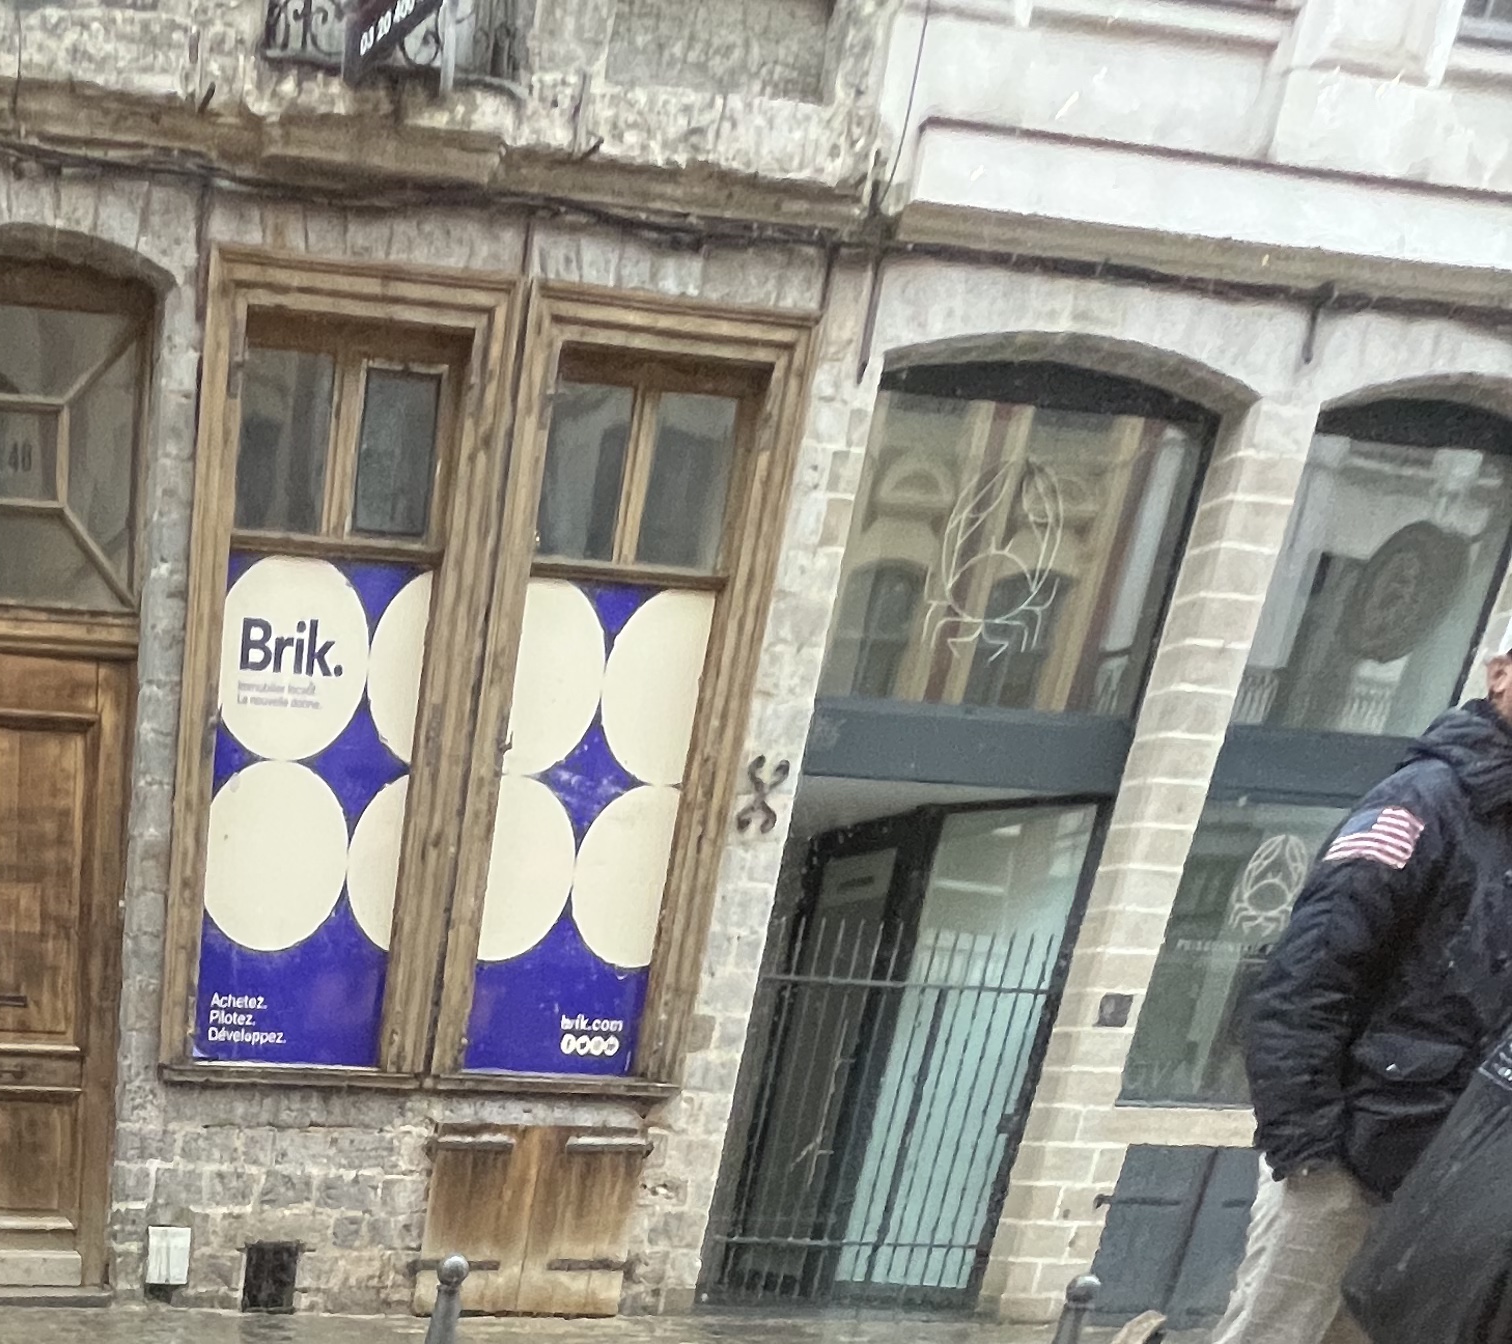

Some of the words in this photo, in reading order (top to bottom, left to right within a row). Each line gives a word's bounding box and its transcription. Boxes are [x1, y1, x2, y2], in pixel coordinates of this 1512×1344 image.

[240, 617, 343, 677] Brik.
[209, 1009, 256, 1026] Pilotez.
[561, 1013, 623, 1032] brik.com
[208, 1026, 287, 1046] Développez.
